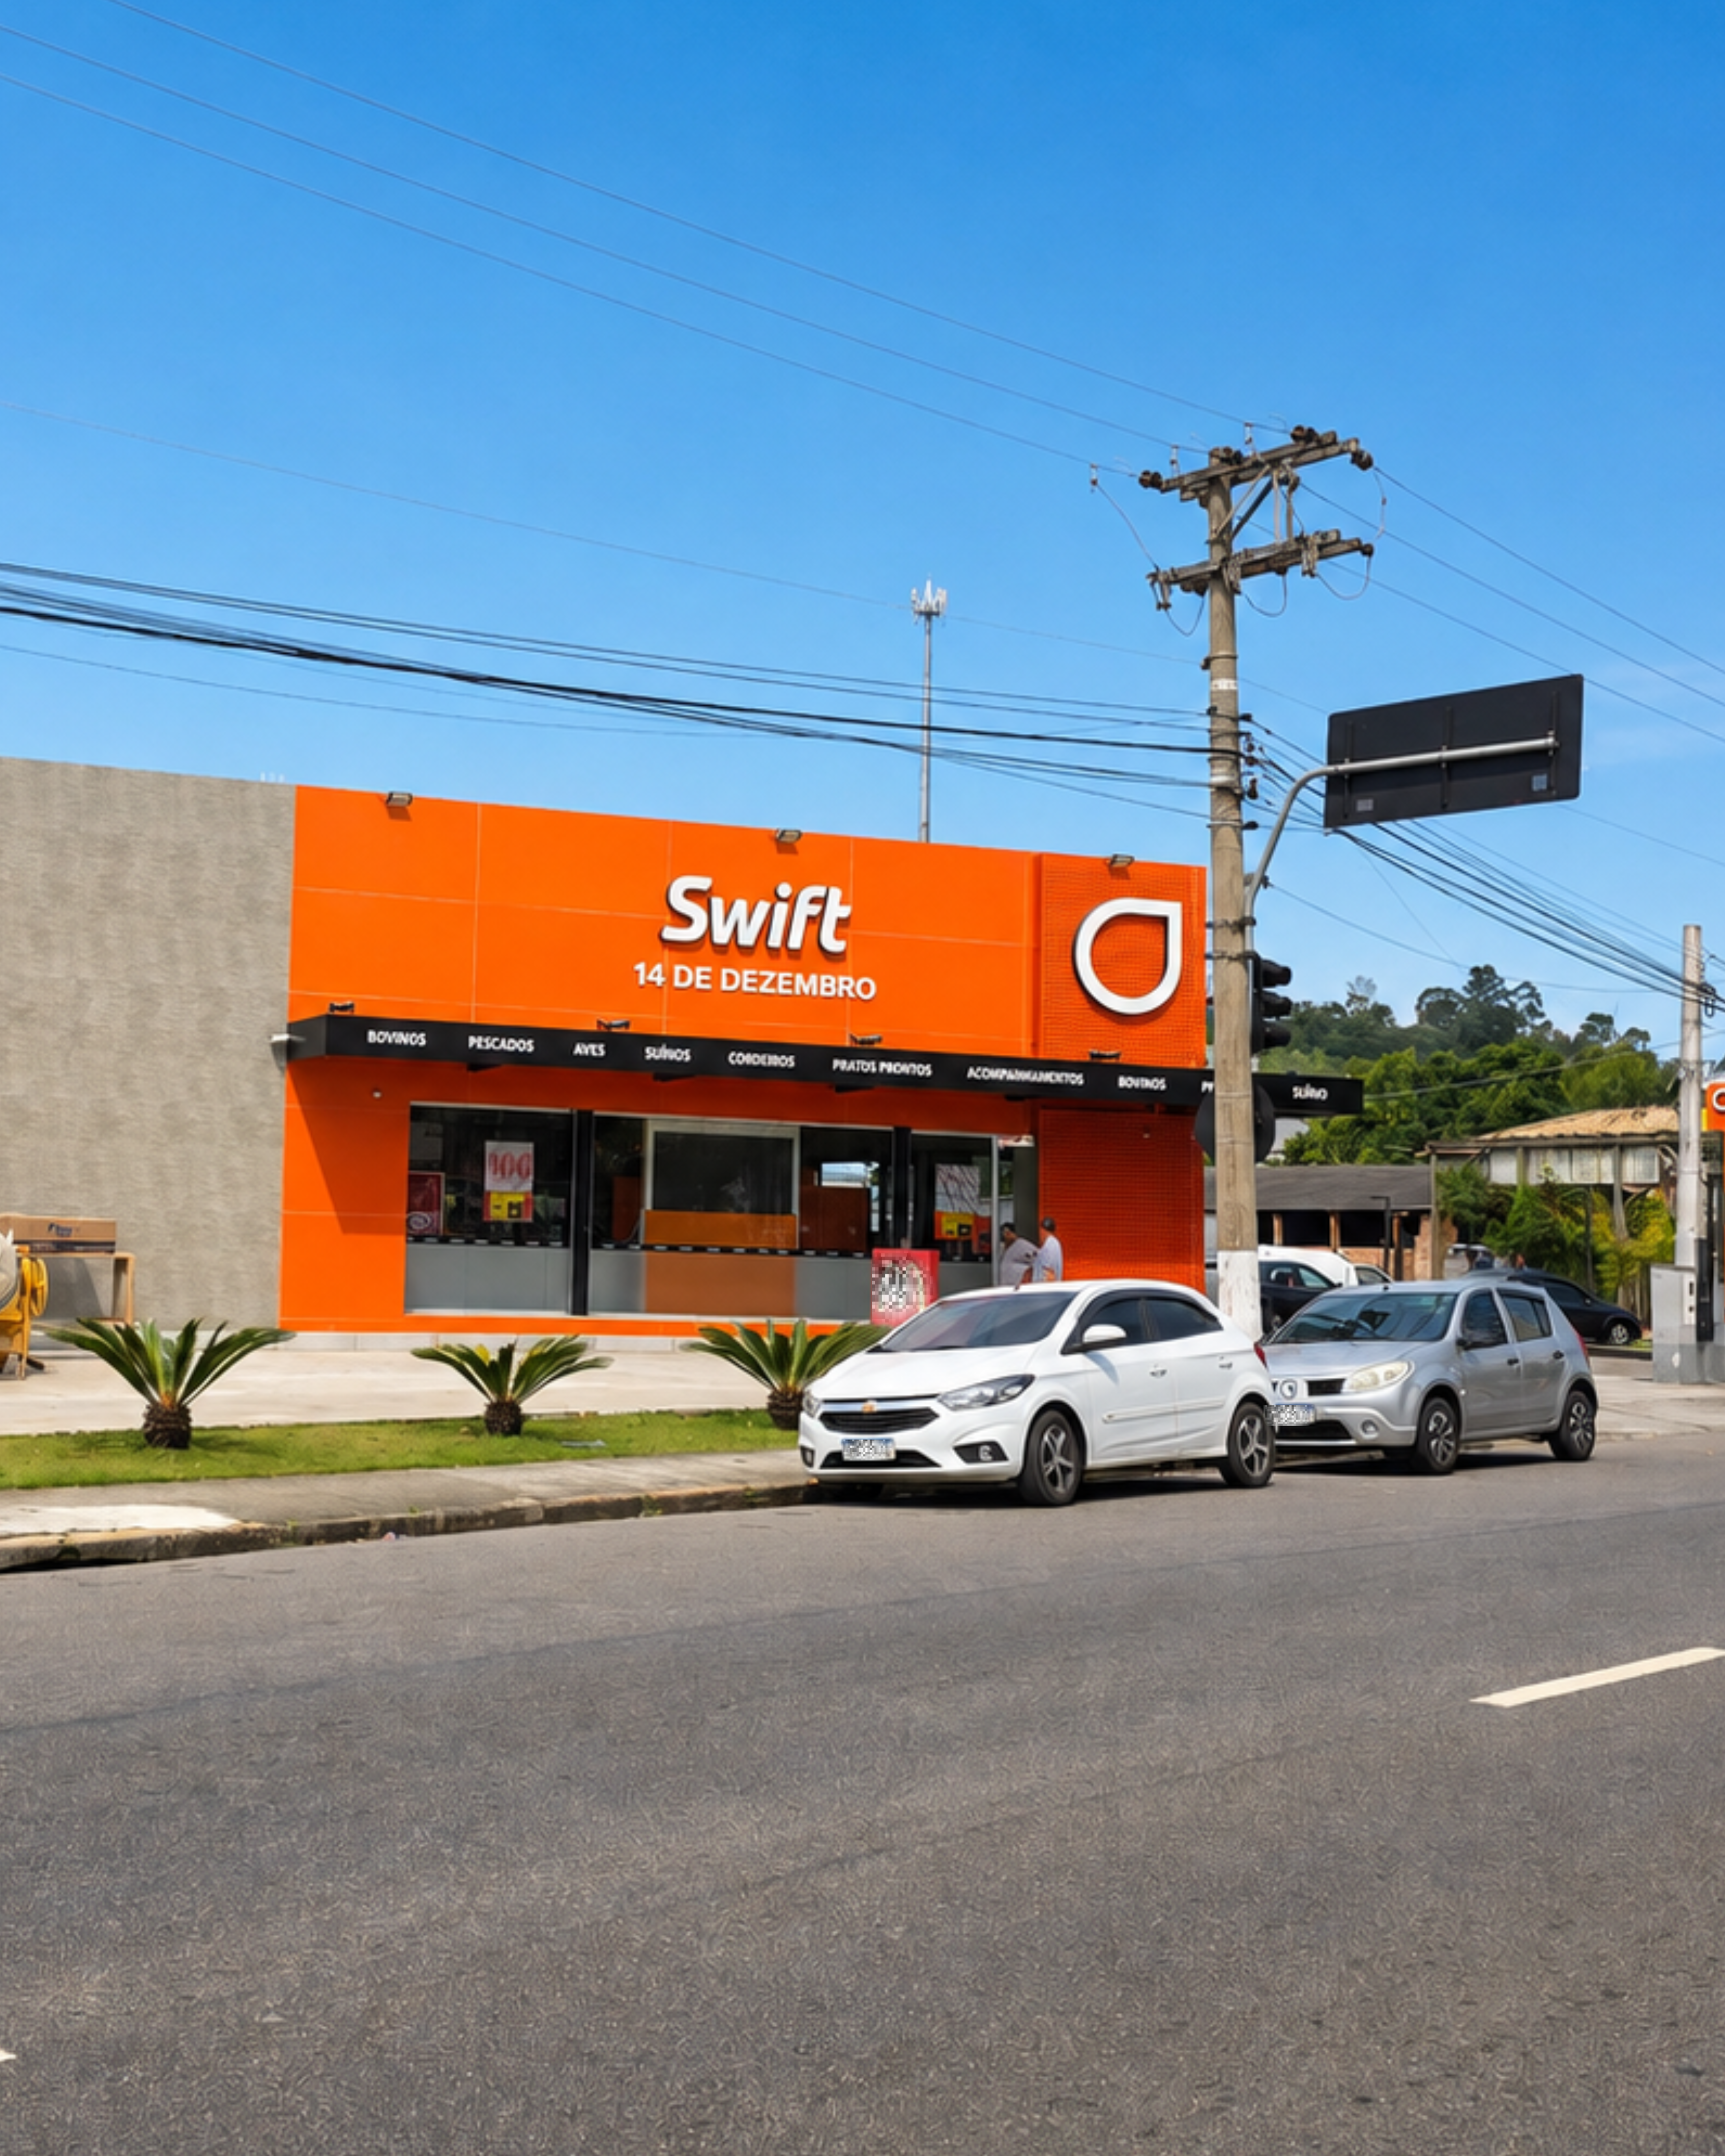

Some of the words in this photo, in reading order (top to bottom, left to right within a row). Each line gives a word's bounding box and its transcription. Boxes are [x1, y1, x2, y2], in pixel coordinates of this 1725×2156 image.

[660, 875, 852, 954] Swift
[634, 962, 665, 987] 14
[673, 964, 712, 990] DE
[720, 967, 877, 1000] DEZEMBRO
[367, 1030, 427, 1046] BOVINOS
[468, 1035, 535, 1053] PESCADOS
[573, 1042, 606, 1057] AVES
